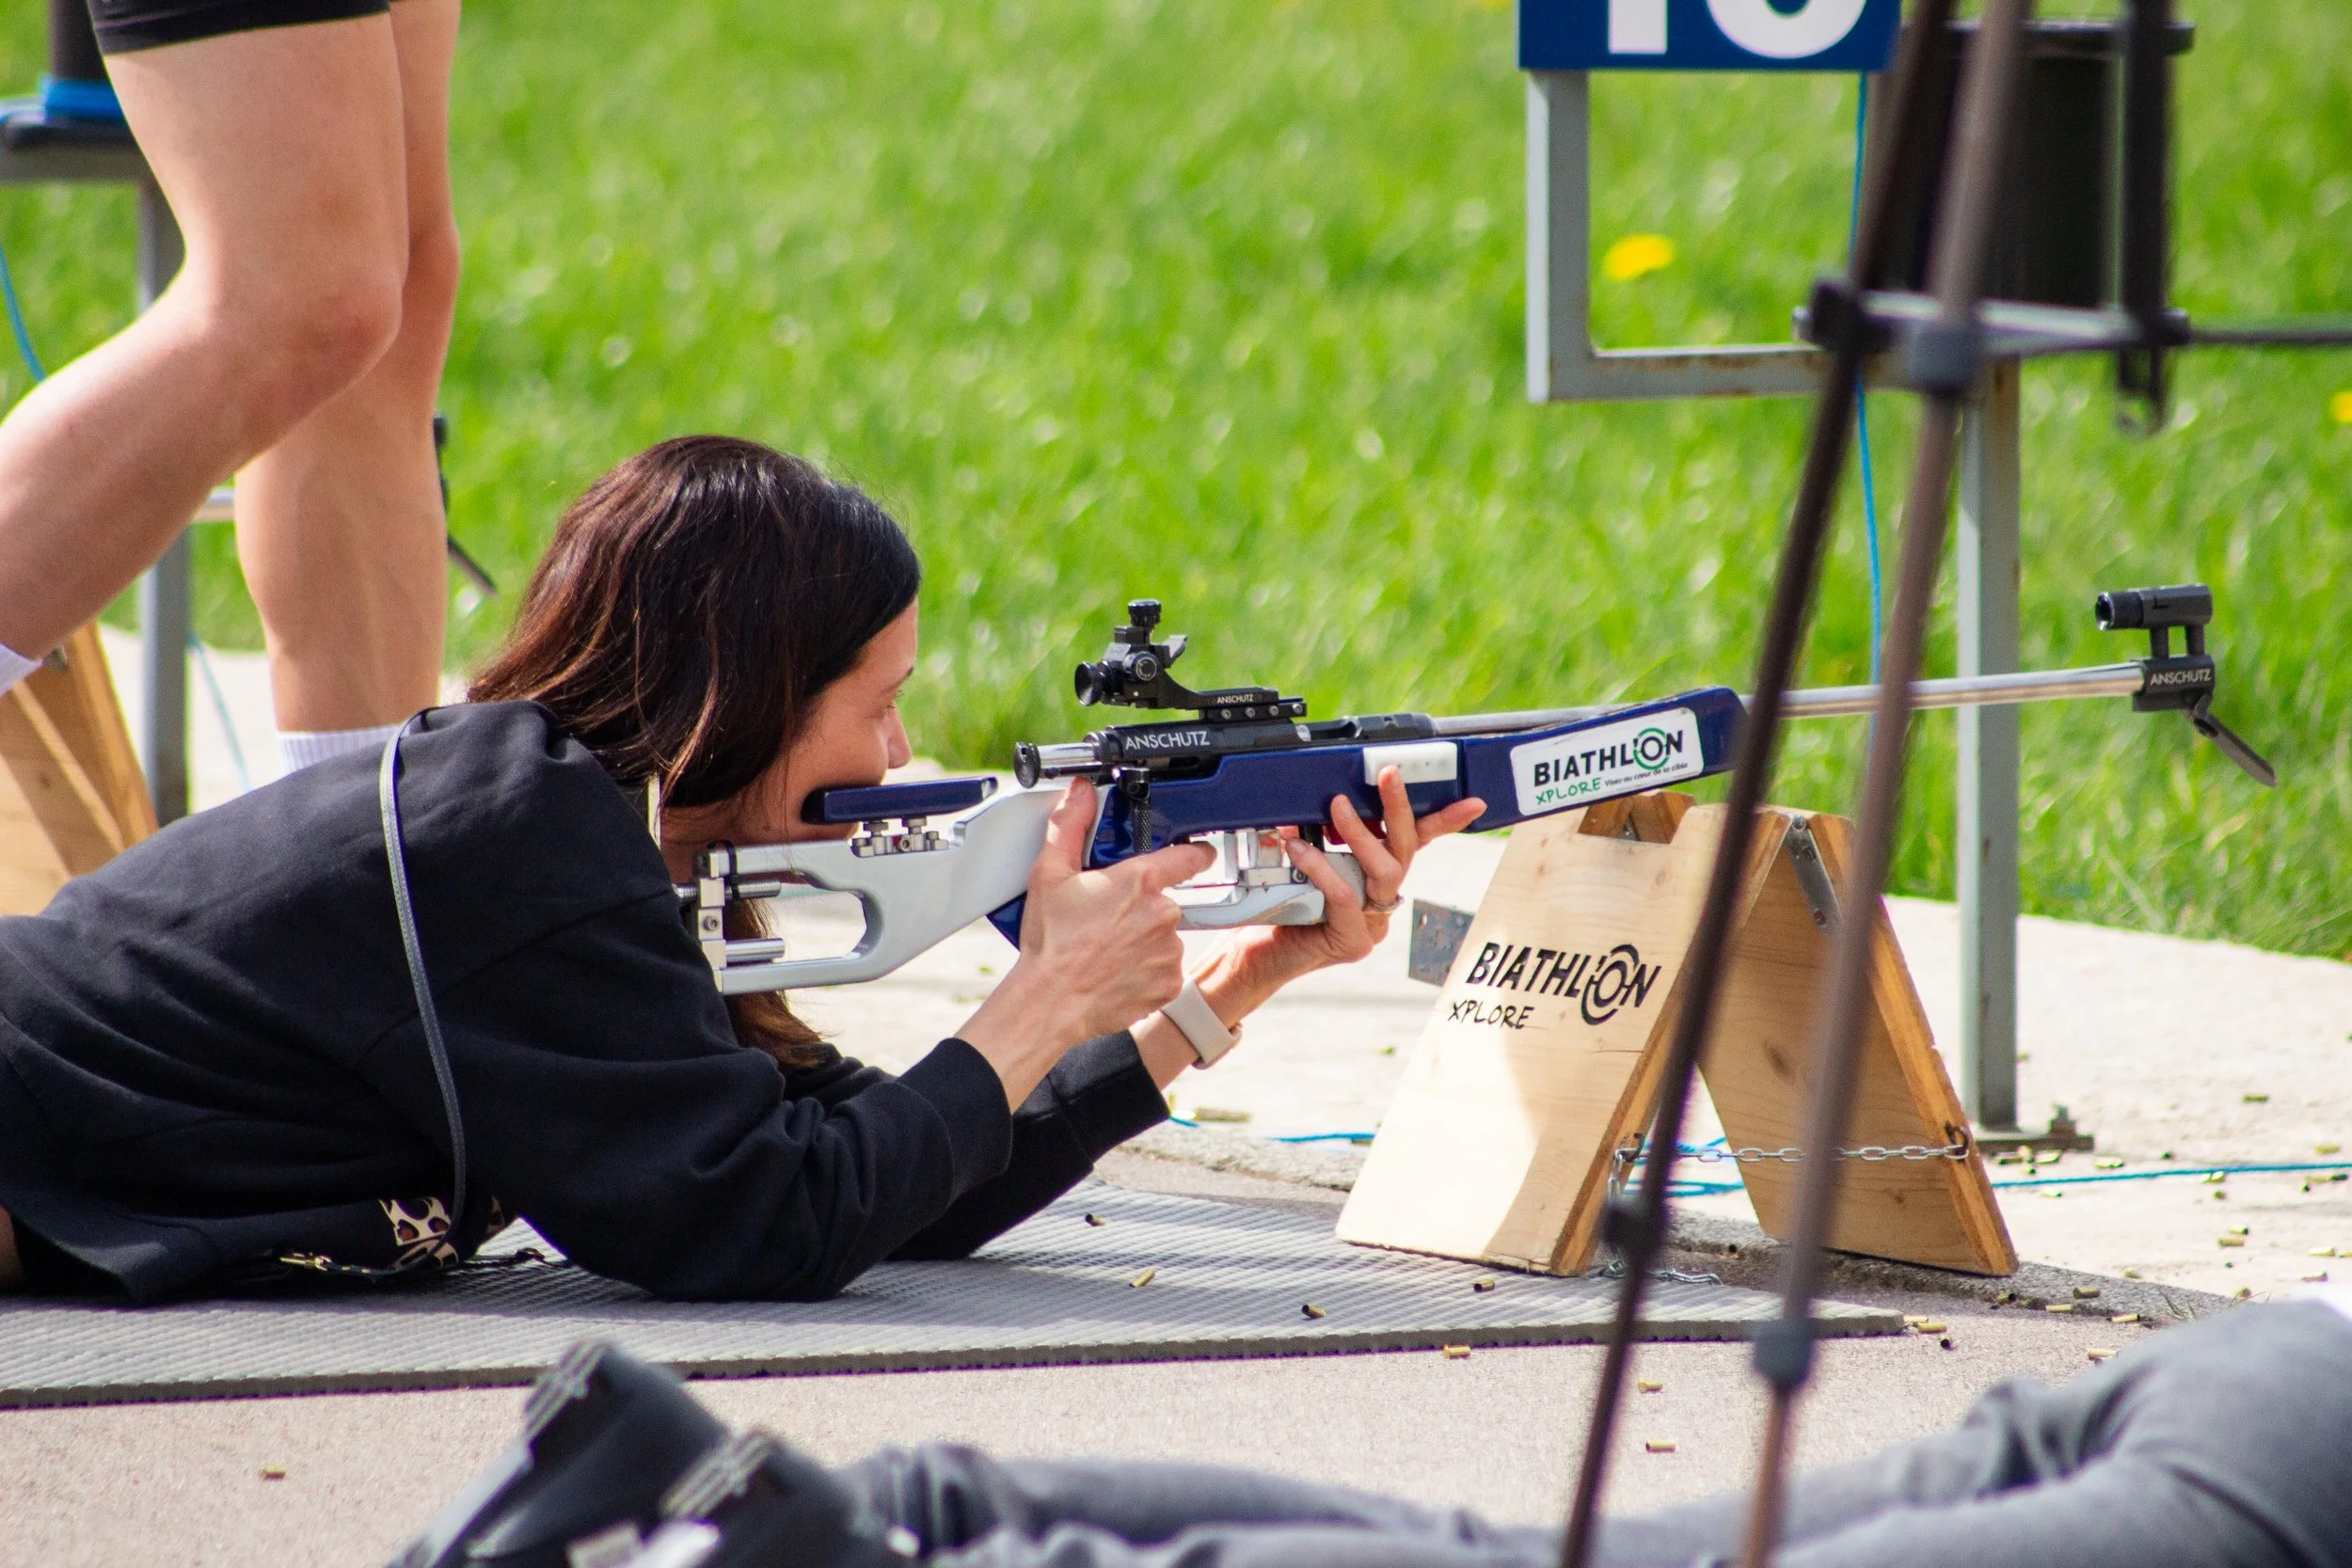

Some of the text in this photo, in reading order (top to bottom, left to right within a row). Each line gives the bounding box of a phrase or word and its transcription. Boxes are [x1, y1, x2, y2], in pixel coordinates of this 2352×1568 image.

[1671, 762, 1688, 771] cible
[1535, 777, 1601, 806] XPLORE
[1447, 999, 1534, 1029] XPLORE
